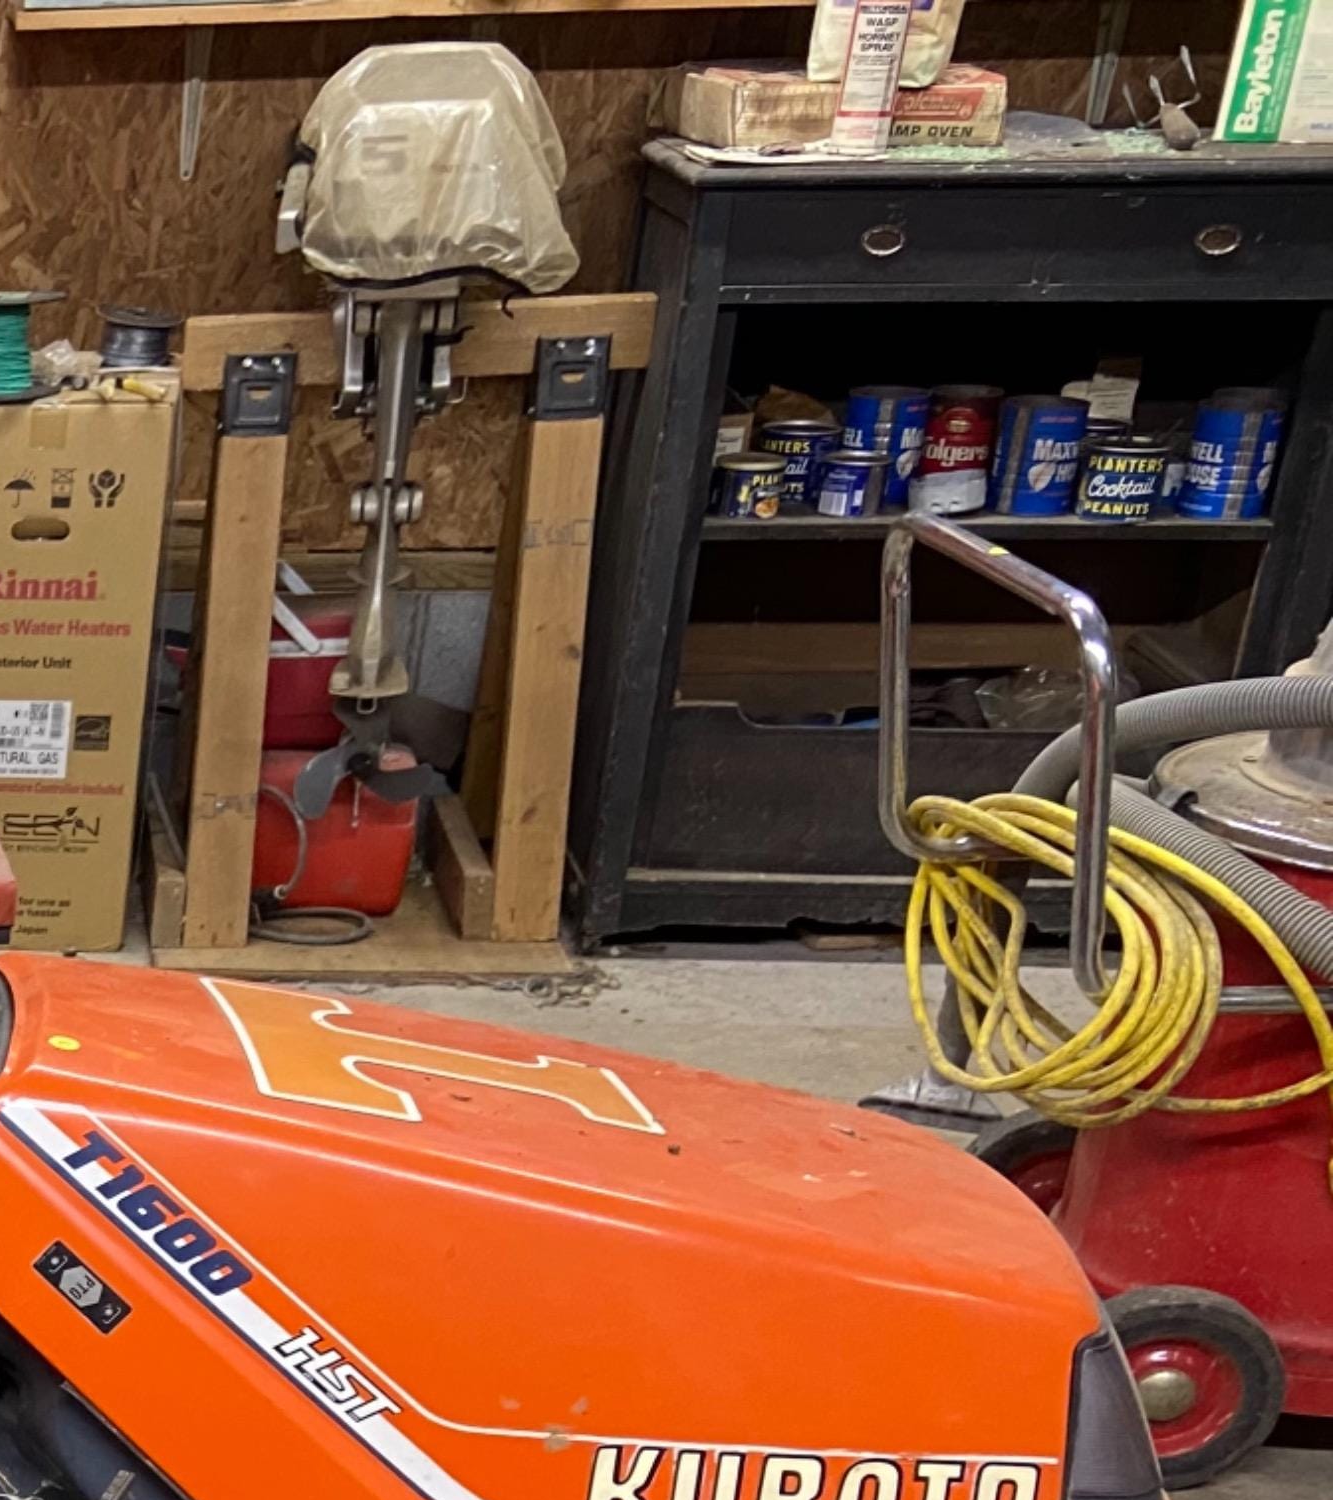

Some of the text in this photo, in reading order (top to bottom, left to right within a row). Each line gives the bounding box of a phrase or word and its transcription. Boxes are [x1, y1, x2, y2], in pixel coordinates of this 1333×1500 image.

[866, 18, 900, 27] WASP
[858, 32, 901, 42] HORNET
[861, 43, 895, 52] SPRAY
[1233, 9, 1286, 134] Bayleton
[928, 126, 974, 138] OVEN
[1089, 456, 1165, 474] PLANTERS
[1088, 474, 1157, 500] Cocktail
[1083, 500, 1150, 515] PEANUTS
[13, 619, 64, 636] Water
[68, 619, 131, 637] Heaters
[42, 657, 73, 669] Unit
[37, 751, 59, 765] GAS
[63, 1130, 253, 1296] T1600
[68, 1274, 96, 1301] PTO
[274, 1325, 404, 1423] HST
